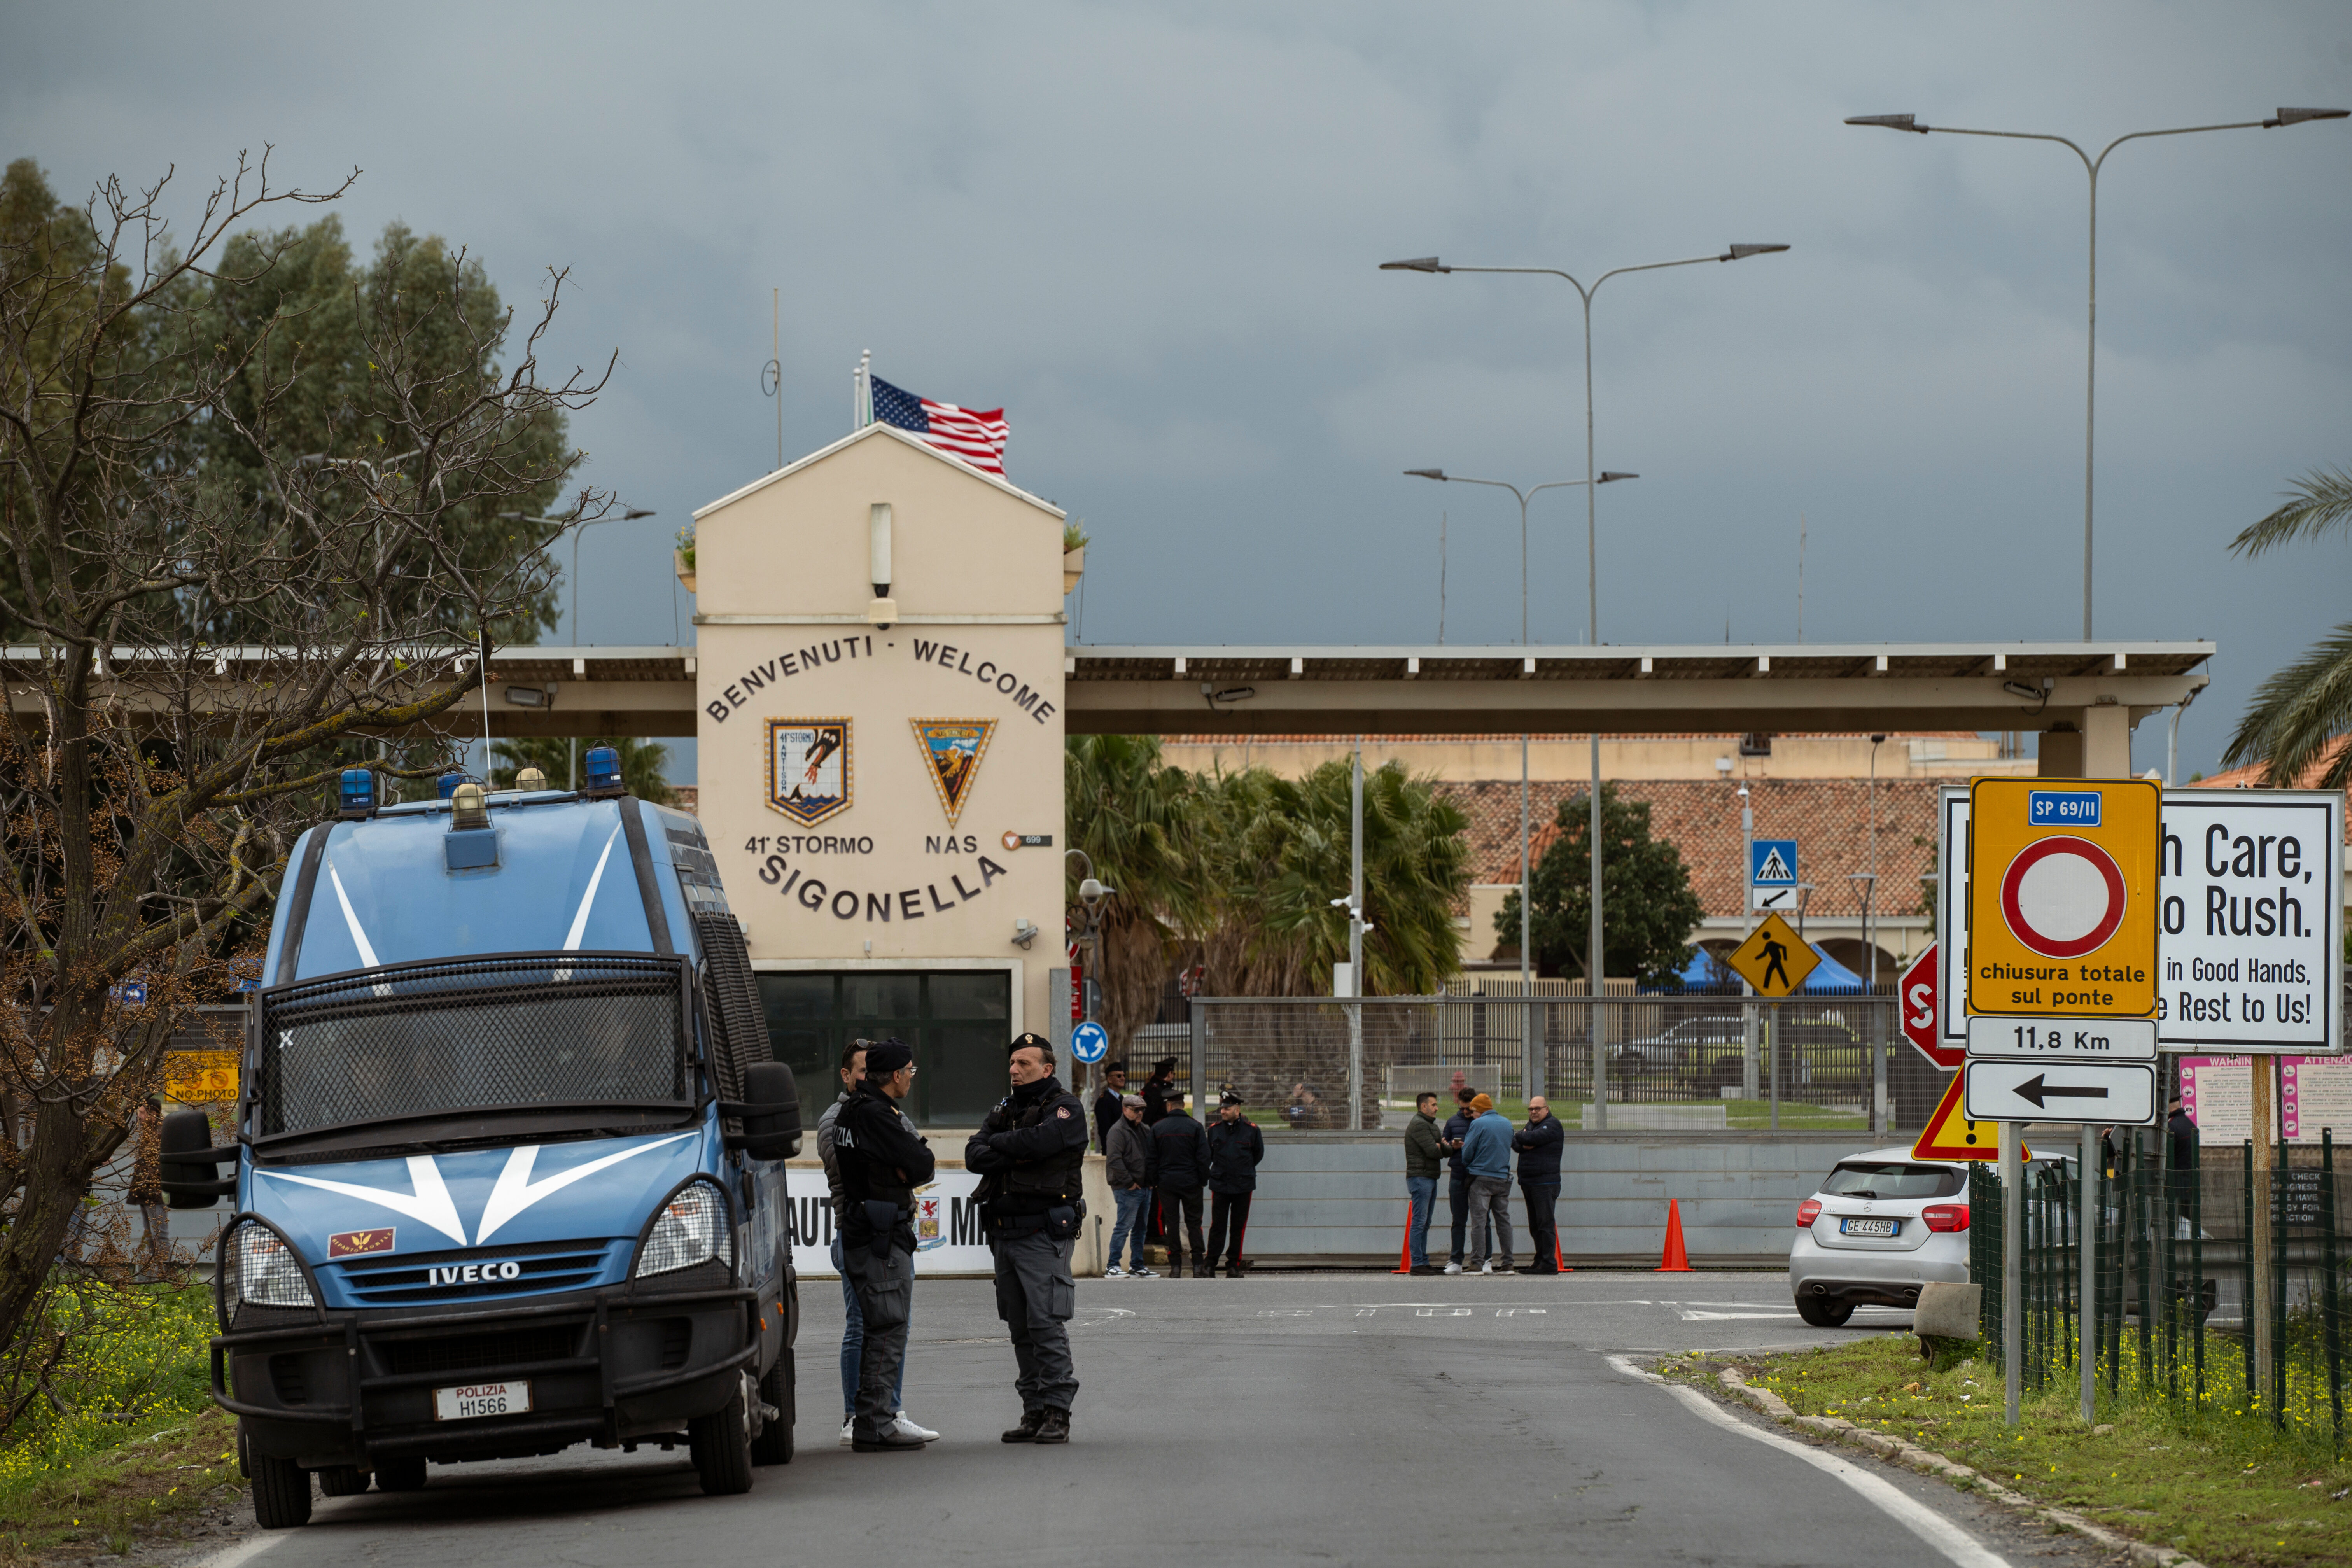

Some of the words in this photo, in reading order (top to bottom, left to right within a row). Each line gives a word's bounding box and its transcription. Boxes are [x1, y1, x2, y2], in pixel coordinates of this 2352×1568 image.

[706, 635, 872, 724] BENVENUTI
[914, 639, 1056, 725] WELCOME
[790, 732, 814, 743] STORMO
[2036, 801, 2053, 816] SP
[777, 836, 874, 854] STORMO
[925, 836, 978, 853] NAS
[2205, 823, 2312, 884] Care,
[758, 854, 1008, 922] SIGONELLA
[2160, 895, 2185, 935] o
[2207, 885, 2311, 938] Rush.
[1980, 962, 2069, 981] chiusura
[2080, 965, 2145, 982] totale
[2167, 957, 2183, 981] in
[2193, 957, 2239, 982] Good
[2248, 958, 2311, 986] Hands,
[2011, 987, 2041, 1004] sul
[2053, 989, 2114, 1007] ponte
[2180, 991, 2231, 1022] Rest
[2242, 992, 2264, 1023] to
[2277, 993, 2311, 1024] Us!
[2014, 1026, 2062, 1050] 11,8
[2074, 1031, 2109, 1050] Km
[2210, 1057, 2253, 1066] WARNIN
[176, 1090, 193, 1099] NO
[197, 1089, 236, 1098] PHOTO
[788, 1197, 832, 1247] AUT
[1848, 1220, 1860, 1231] GE
[1862, 1221, 1892, 1233] 445HB
[332, 1238, 359, 1253] REPARTO
[364, 1232, 392, 1252] MOBILE
[429, 1261, 520, 1286] IVECO
[456, 1384, 507, 1398] POLIZIA
[460, 1397, 507, 1416] H1566
